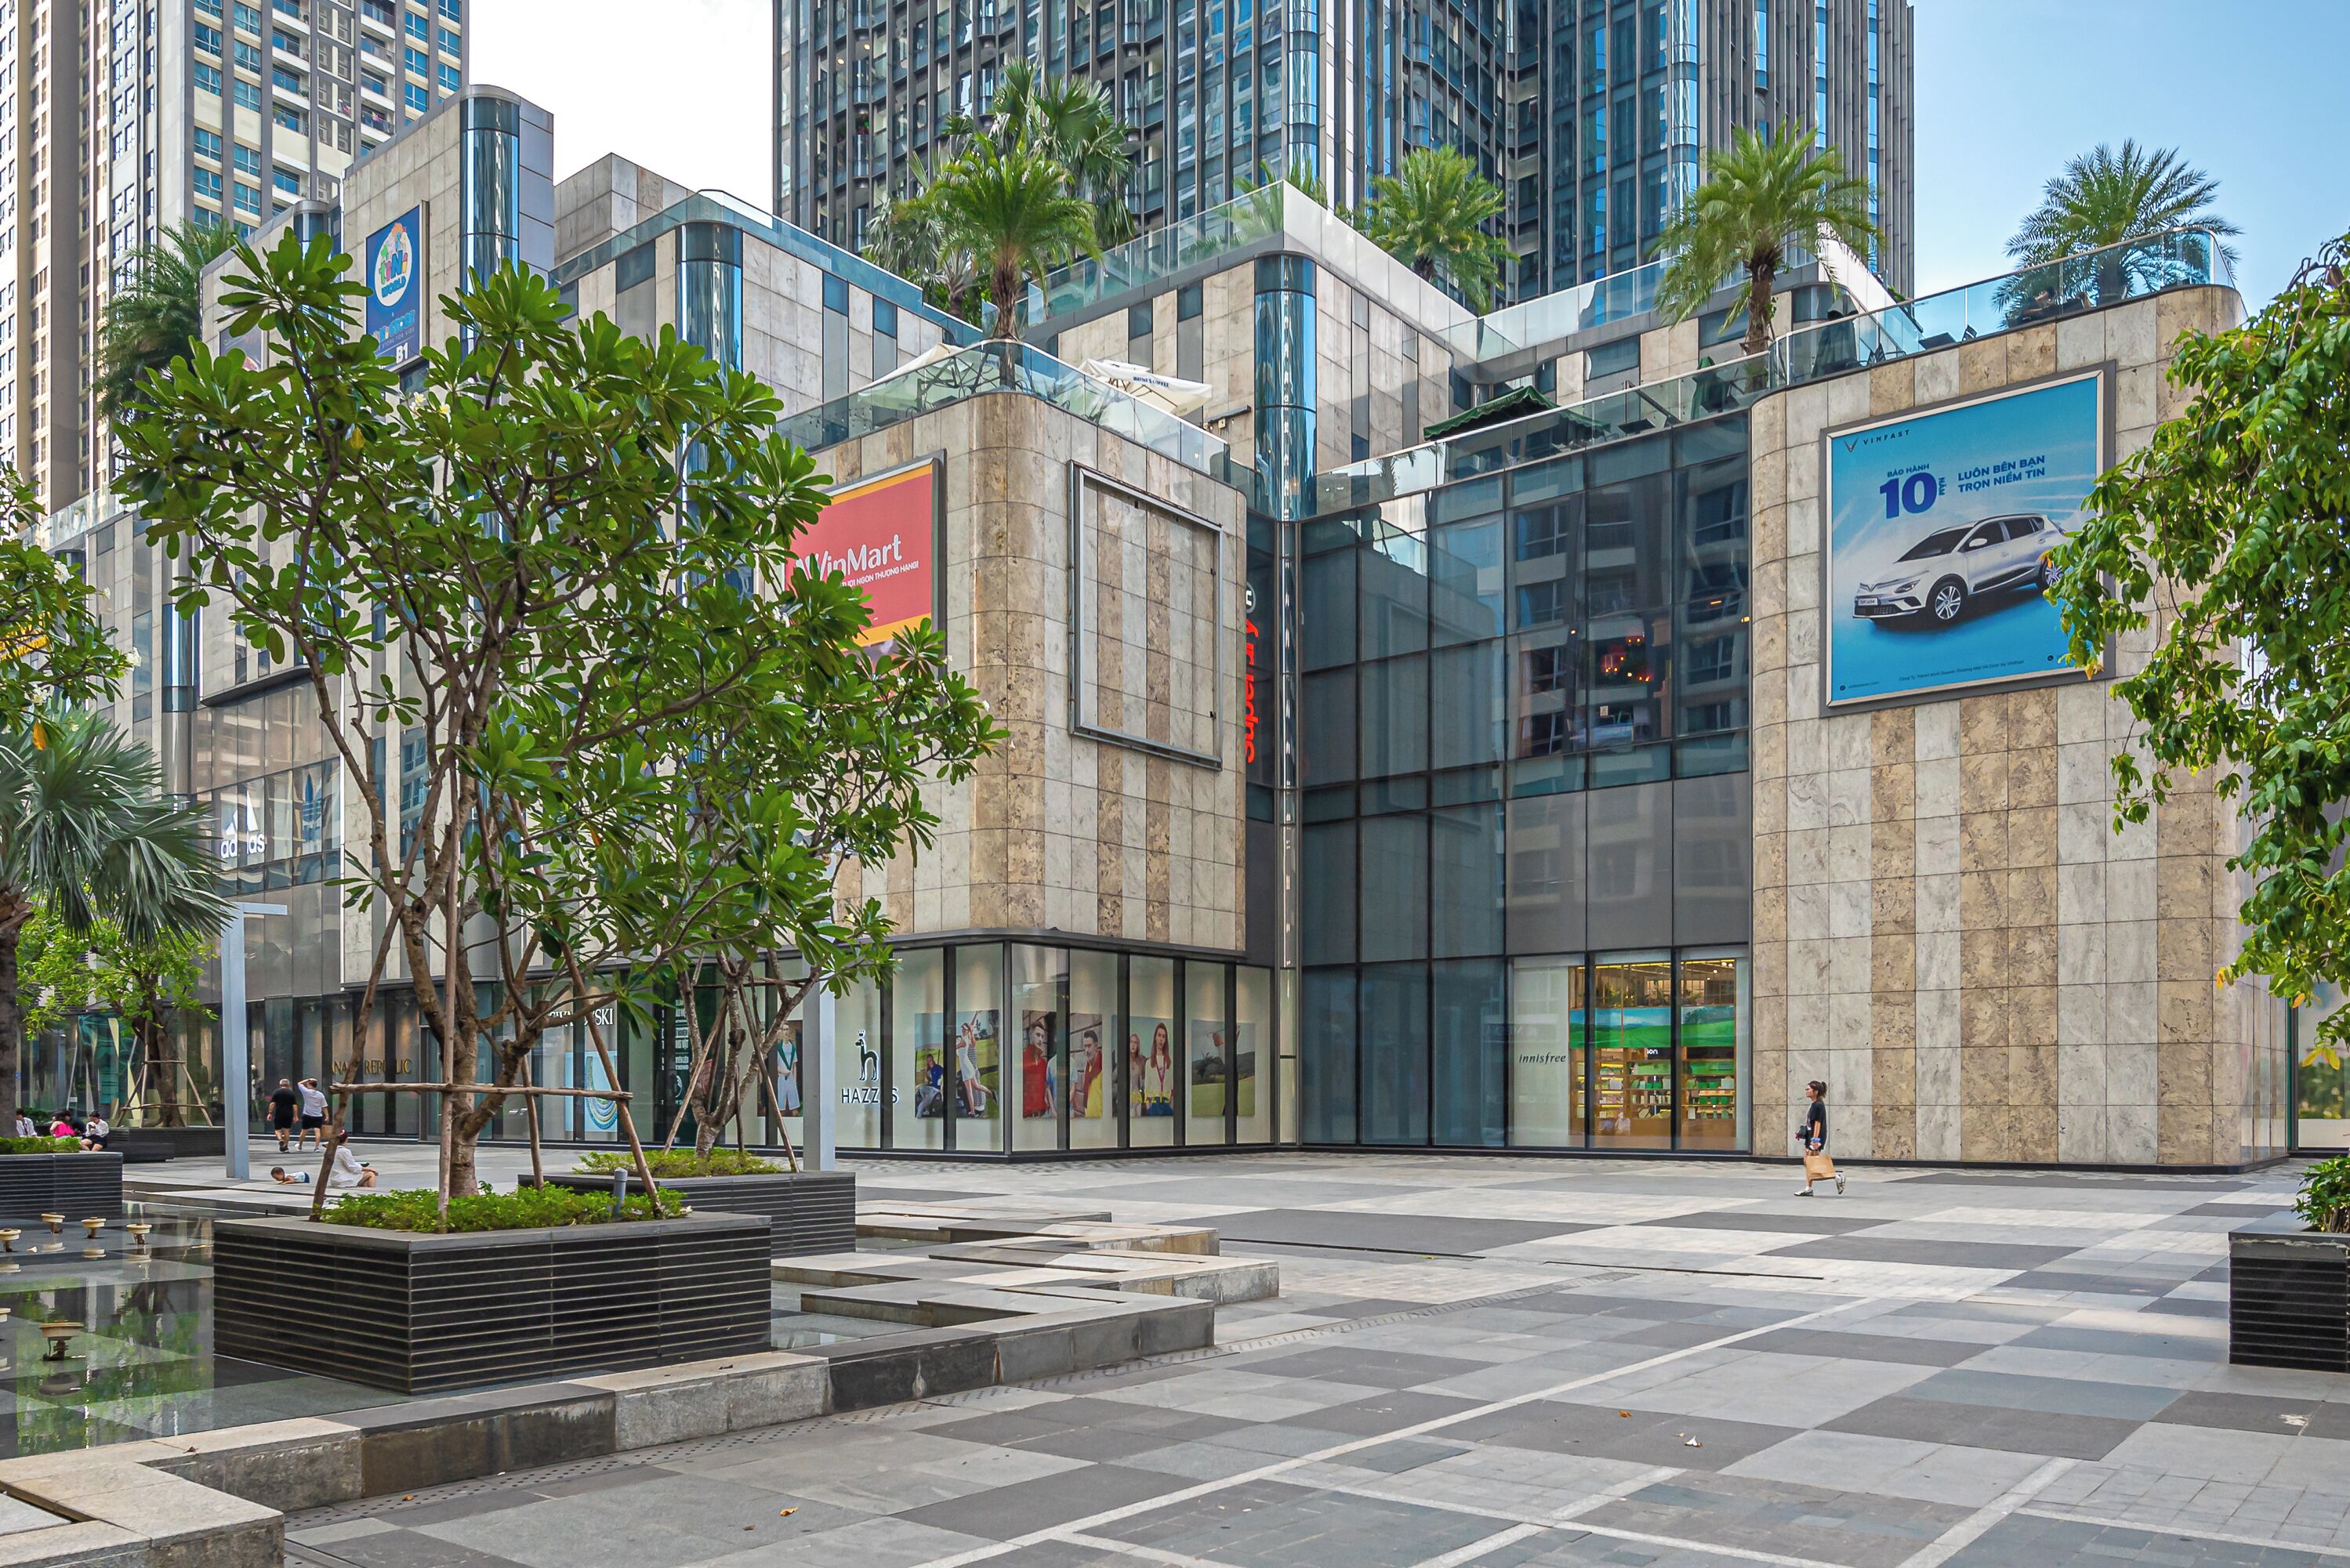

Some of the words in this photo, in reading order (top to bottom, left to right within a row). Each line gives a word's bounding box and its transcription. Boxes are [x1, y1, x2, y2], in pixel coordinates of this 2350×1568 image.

[381, 276, 407, 299] WORLD
[396, 342, 408, 364] B1
[1862, 429, 1909, 446] VINFAST
[1906, 463, 1930, 474] HÀNH
[1958, 466, 1990, 481] LUÔN
[1993, 461, 2016, 474] BÊN
[2019, 455, 2045, 469] BẠN
[1957, 479, 1990, 493] TRỌN
[2025, 467, 2045, 479] TIN
[1879, 472, 1938, 520] 10
[796, 534, 902, 581] WinMart
[856, 573, 875, 586] NGON
[220, 831, 265, 859] adas
[1519, 1052, 1567, 1065] innisfree
[841, 1087, 899, 1104] HAZZS
